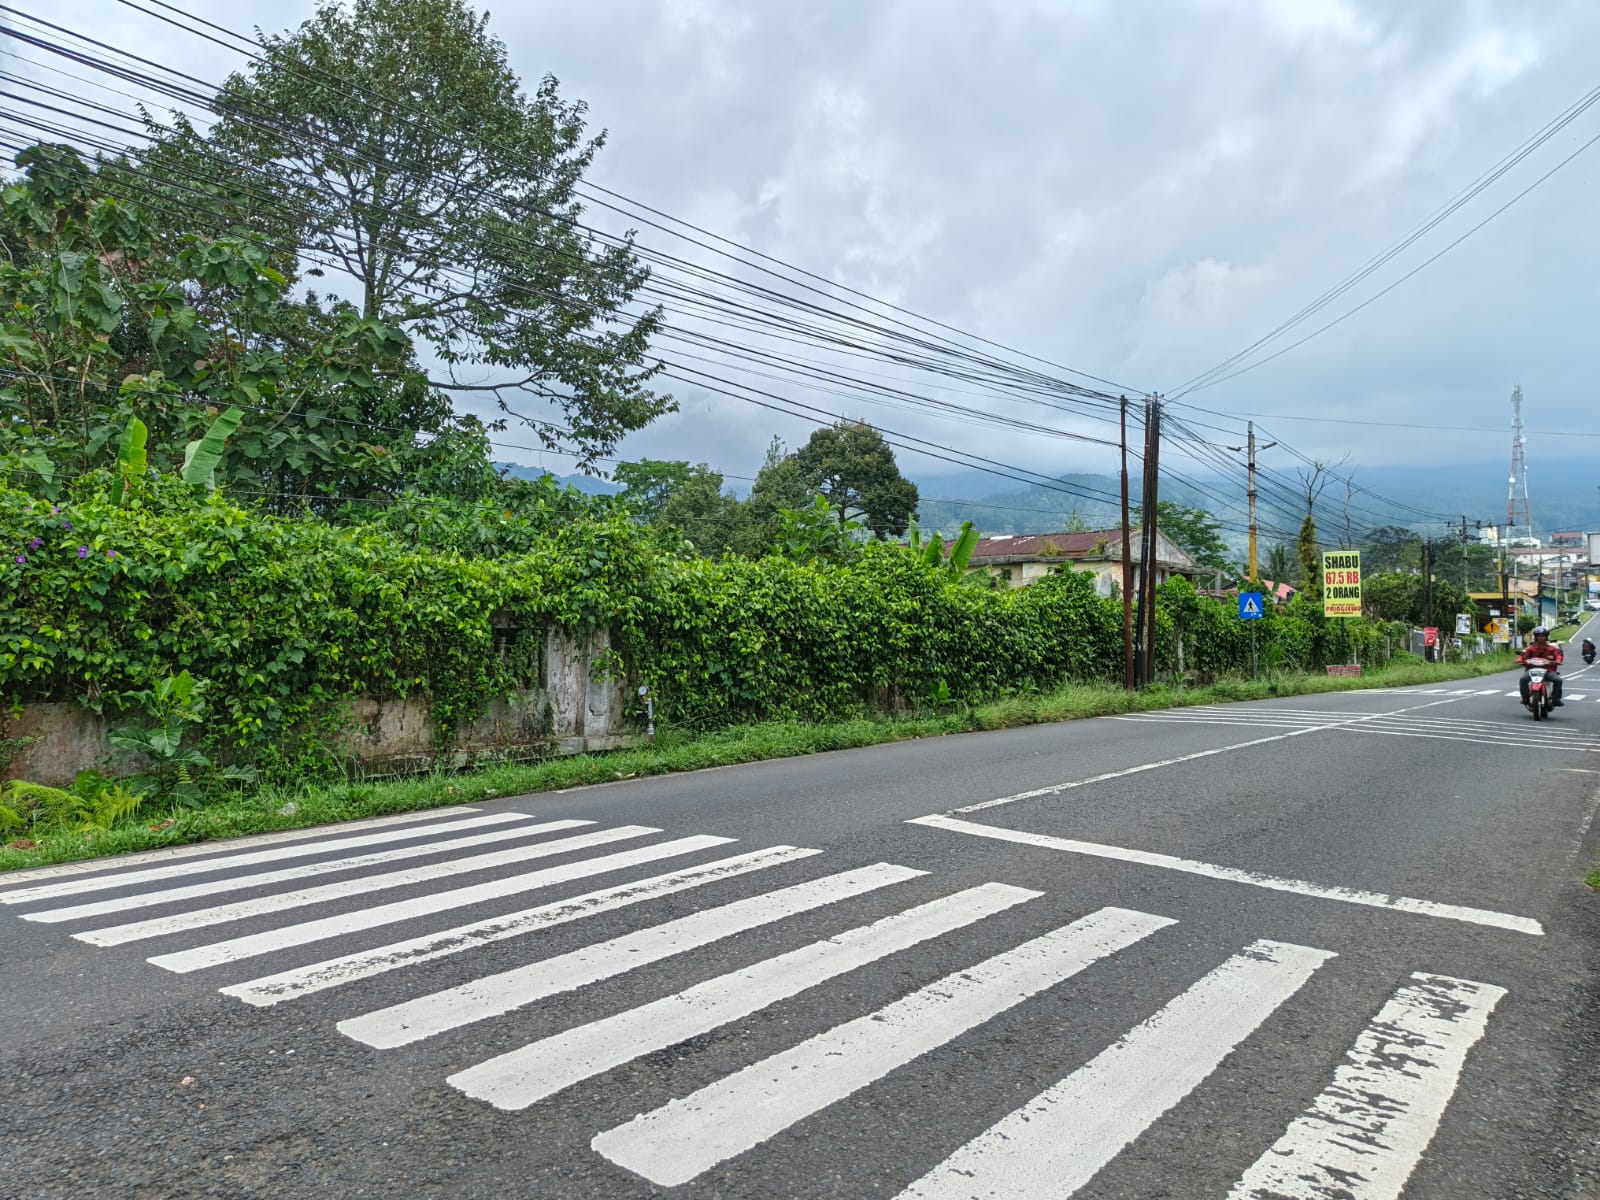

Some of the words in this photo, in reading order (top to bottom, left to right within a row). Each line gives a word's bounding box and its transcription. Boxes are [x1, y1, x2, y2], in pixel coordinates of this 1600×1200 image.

[1325, 555, 1358, 569] SHABU
[1325, 571, 1344, 585] 67.5
[1346, 571, 1359, 585] RB
[1326, 587, 1331, 599] 2
[1333, 586, 1360, 598] ORANG
